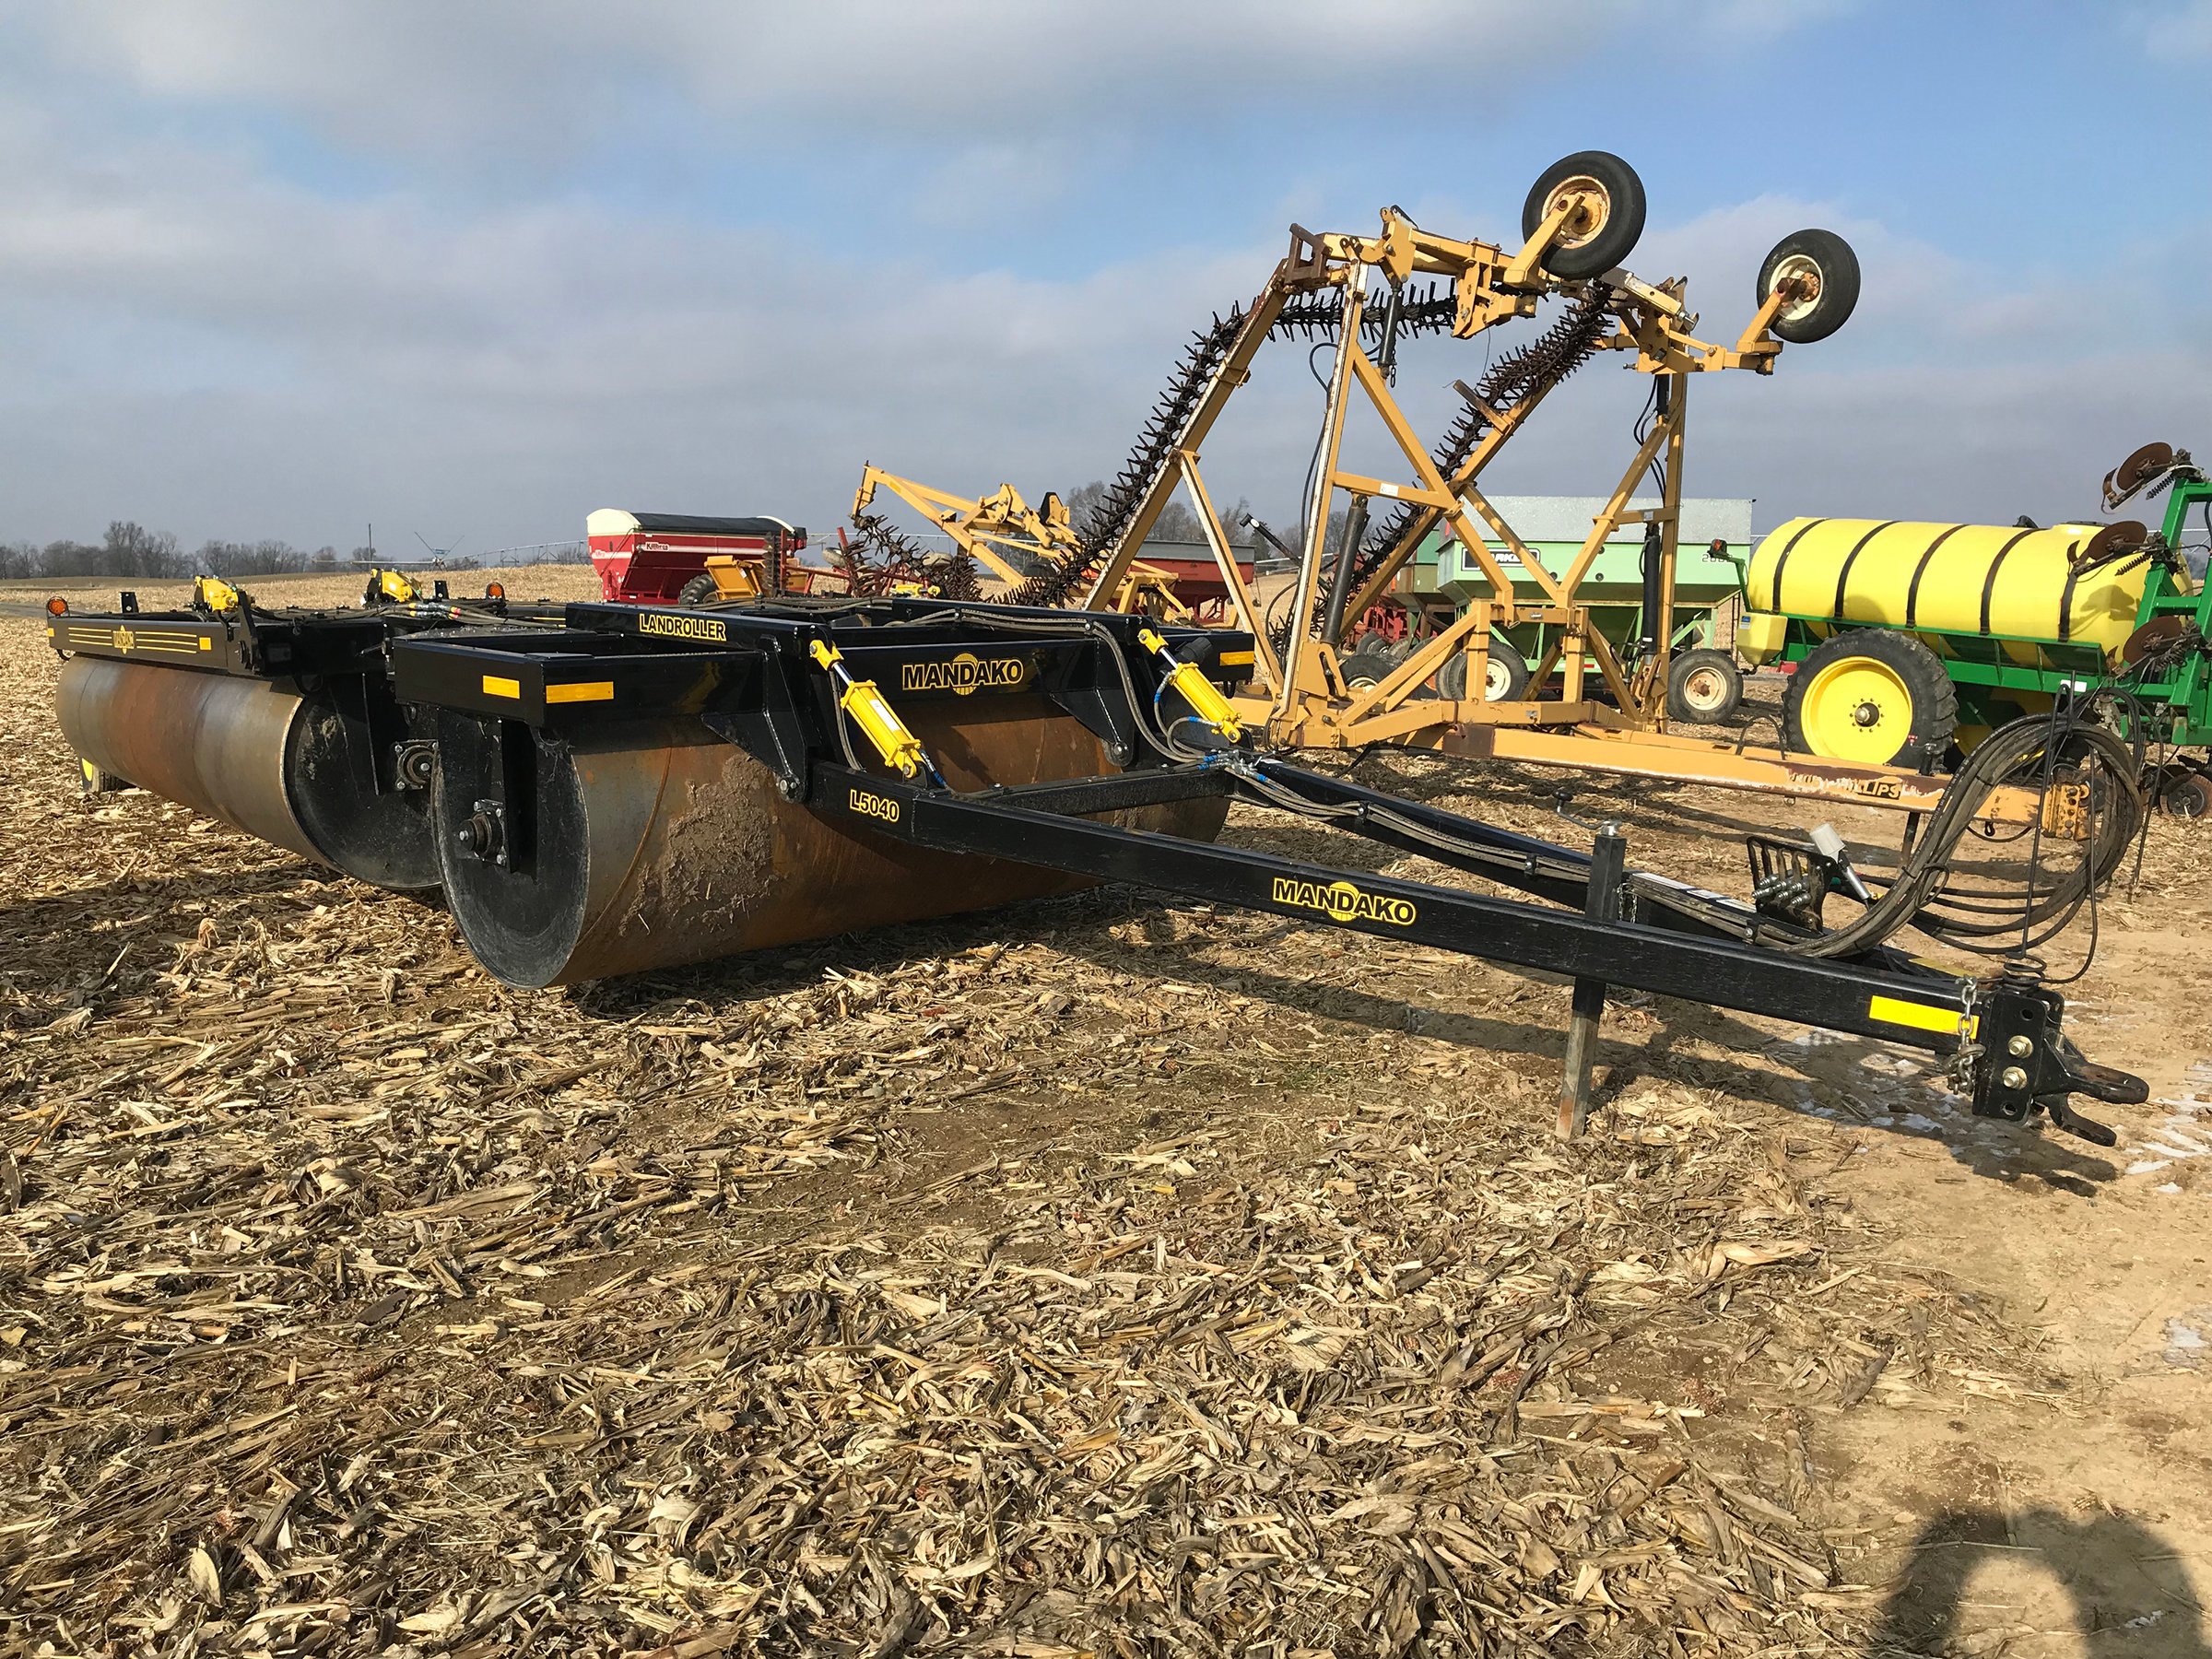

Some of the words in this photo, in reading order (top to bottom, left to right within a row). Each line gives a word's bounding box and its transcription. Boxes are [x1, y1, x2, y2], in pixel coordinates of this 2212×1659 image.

[639, 613, 727, 641] LANDROLLER
[902, 659, 1024, 690] MANDAKO
[850, 789, 900, 822] L5040
[1273, 877, 1417, 925] MANDAKO
